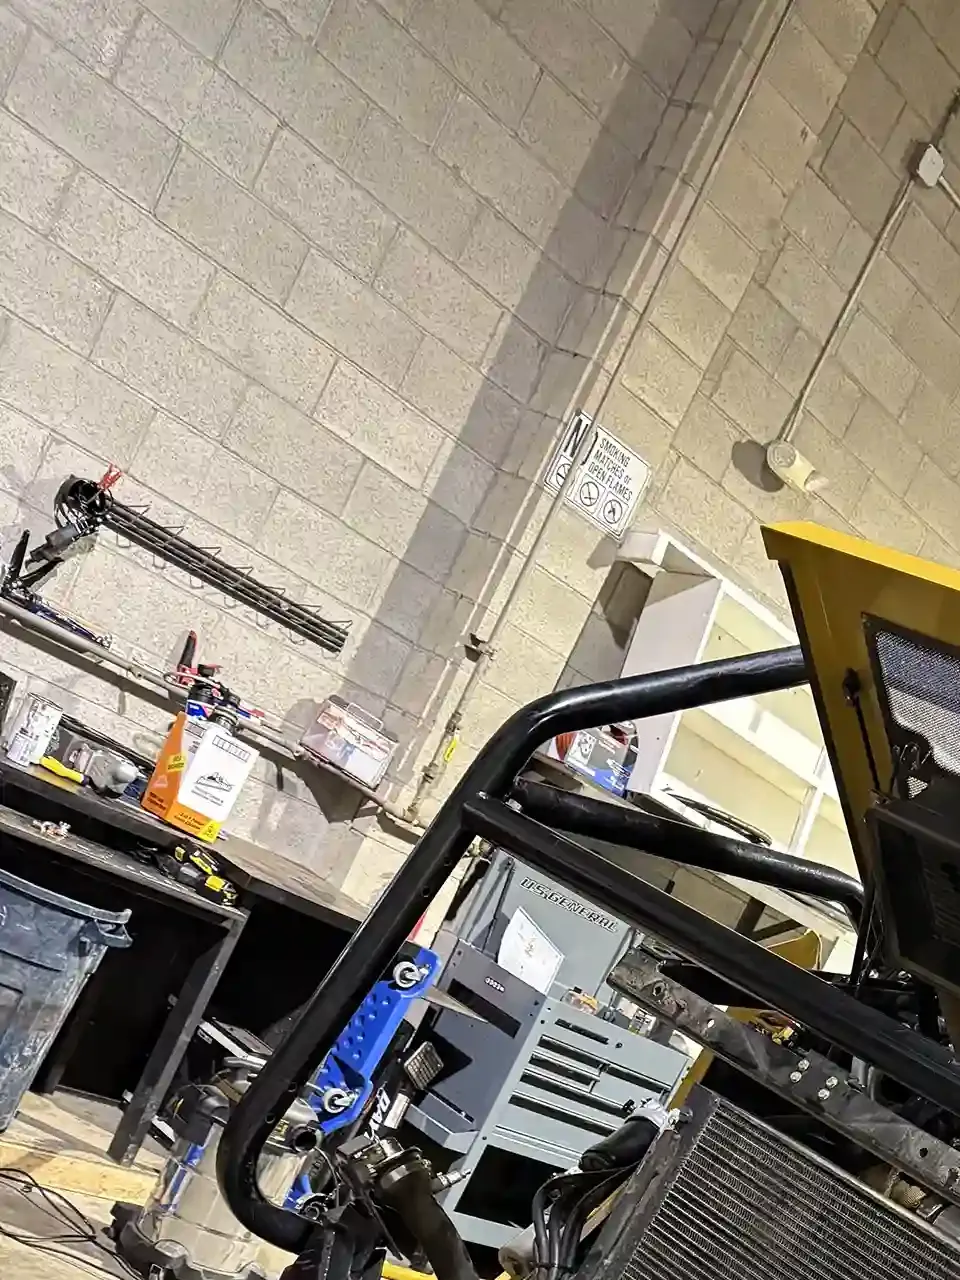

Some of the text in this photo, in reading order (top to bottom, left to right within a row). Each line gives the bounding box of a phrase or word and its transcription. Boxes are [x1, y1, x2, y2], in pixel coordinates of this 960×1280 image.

[593, 449, 625, 480] MATCHES
[599, 438, 631, 467] SMOKING
[587, 461, 633, 501] OPEN FLAMES
